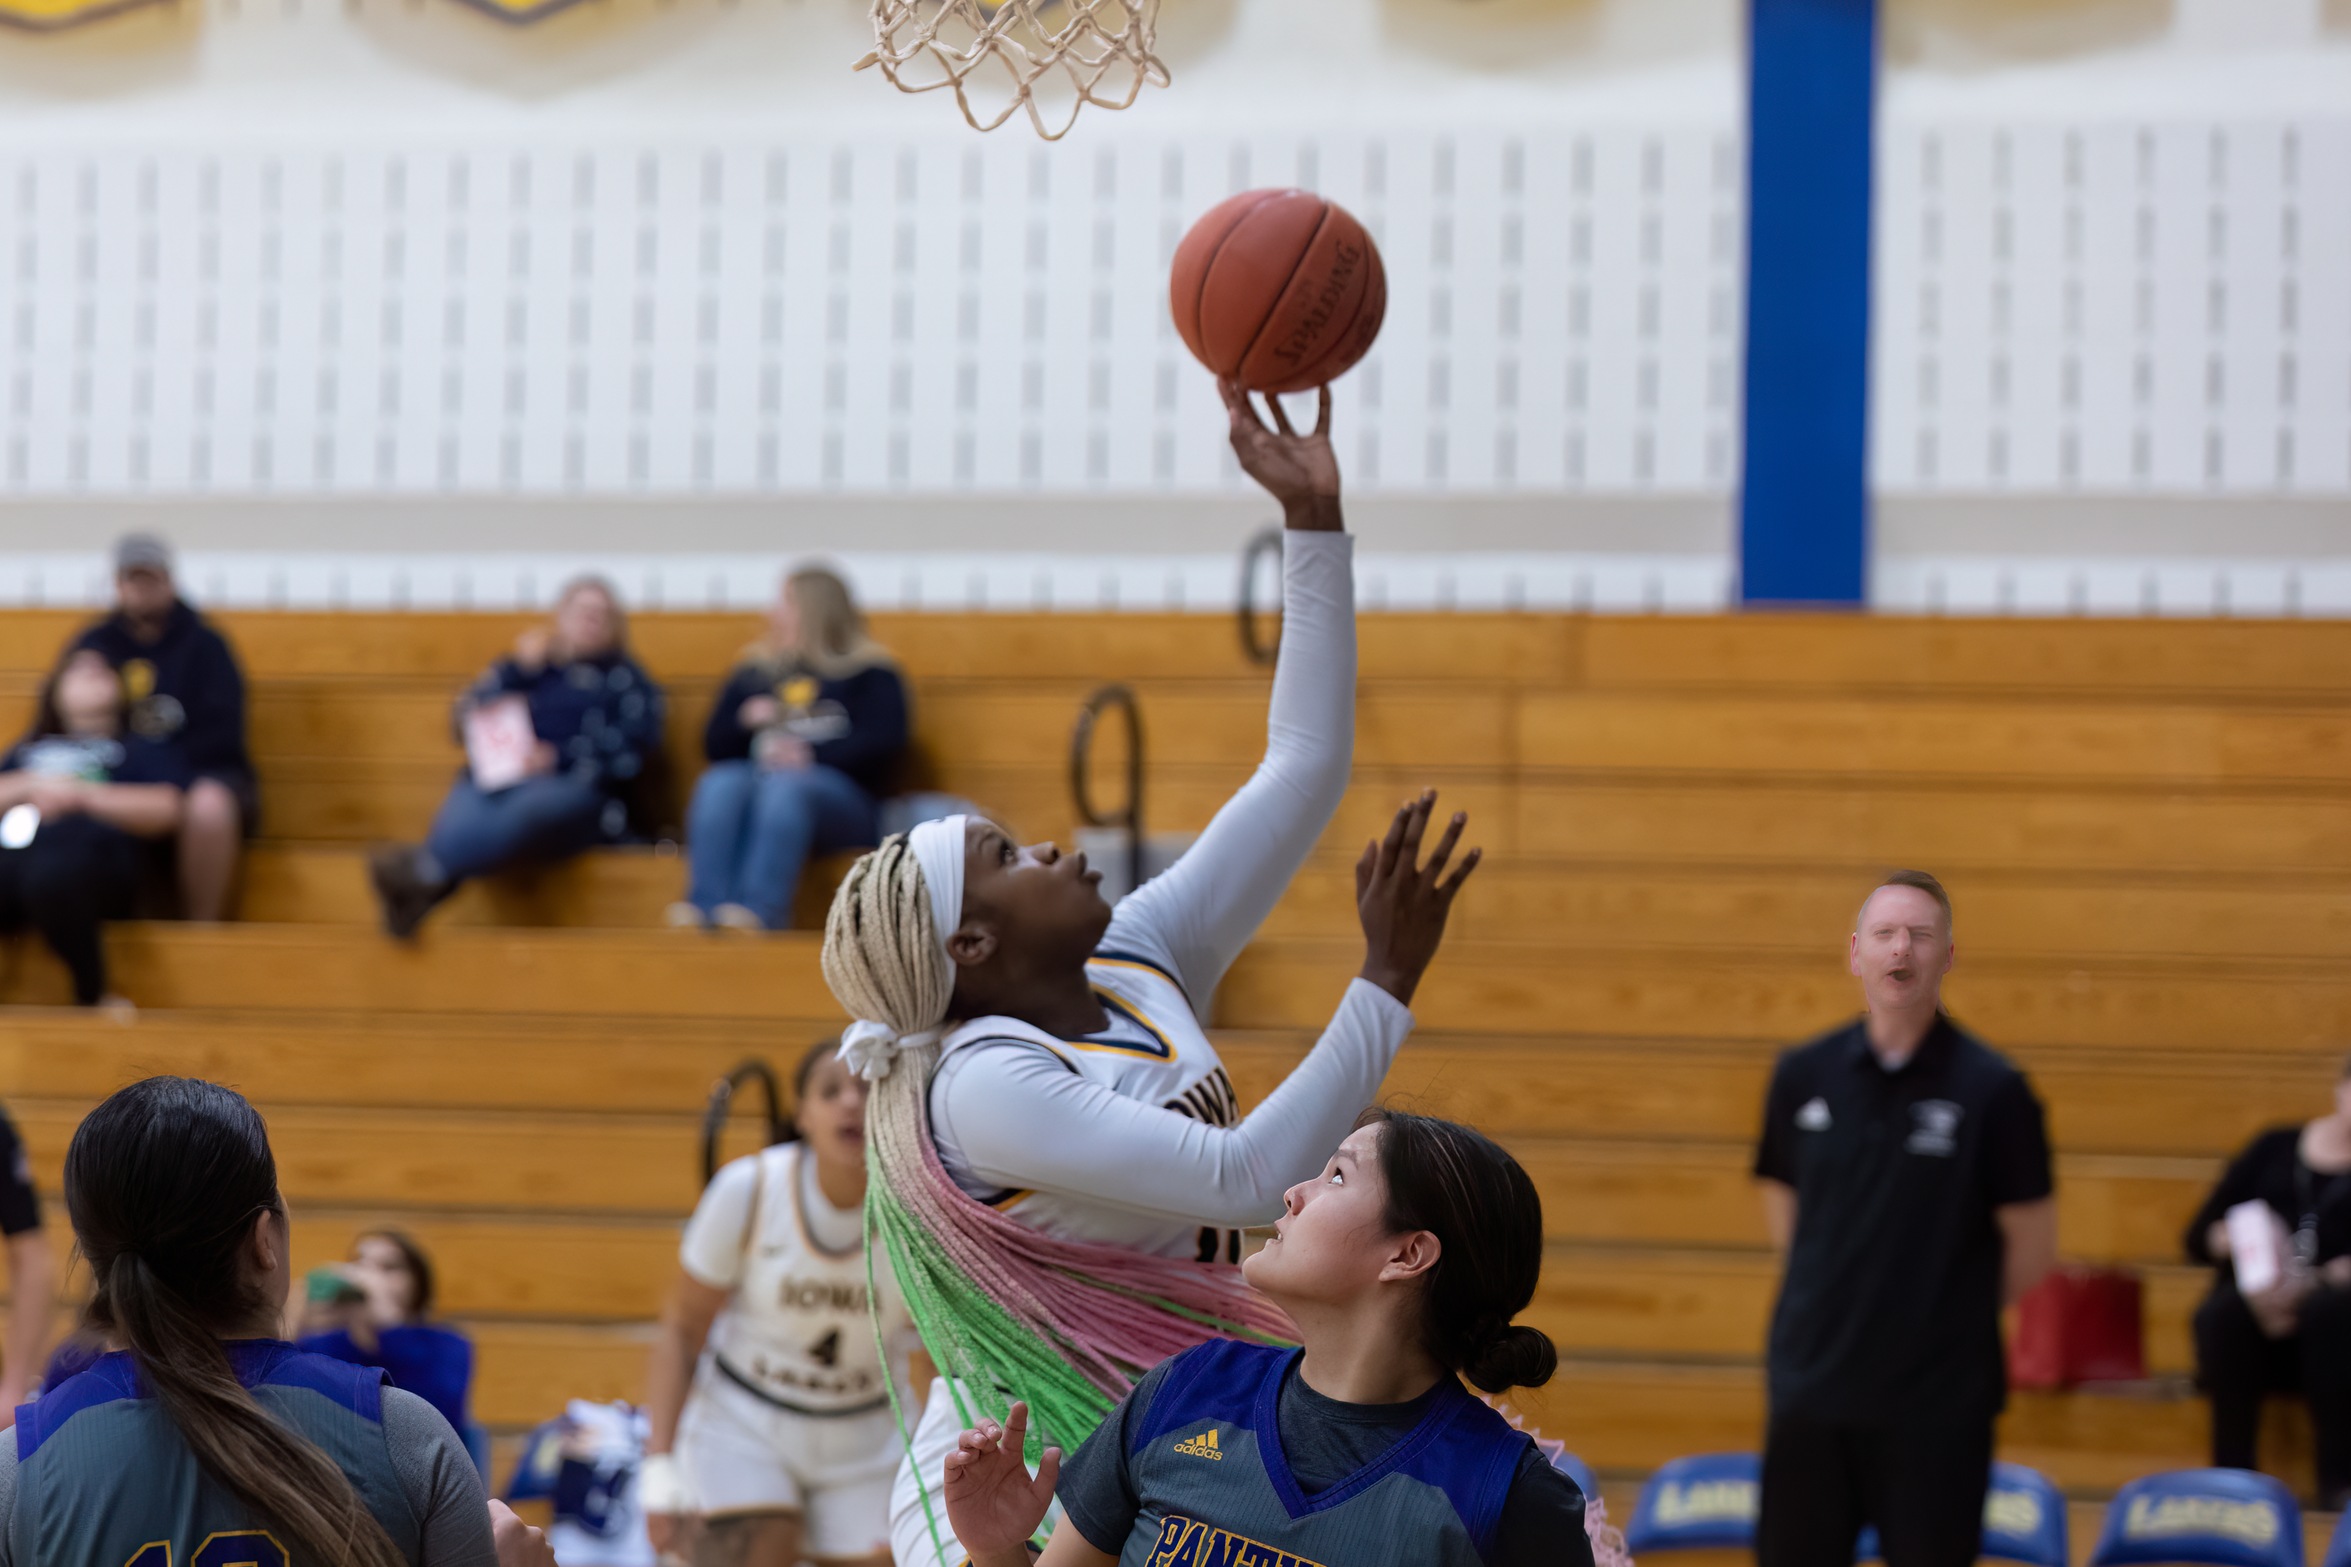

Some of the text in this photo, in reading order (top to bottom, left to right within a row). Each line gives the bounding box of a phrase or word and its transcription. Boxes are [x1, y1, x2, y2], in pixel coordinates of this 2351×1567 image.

[1274, 238, 1361, 366] SPALDING
[809, 1325, 842, 1369] 4
[1173, 1441, 1224, 1461] adidas
